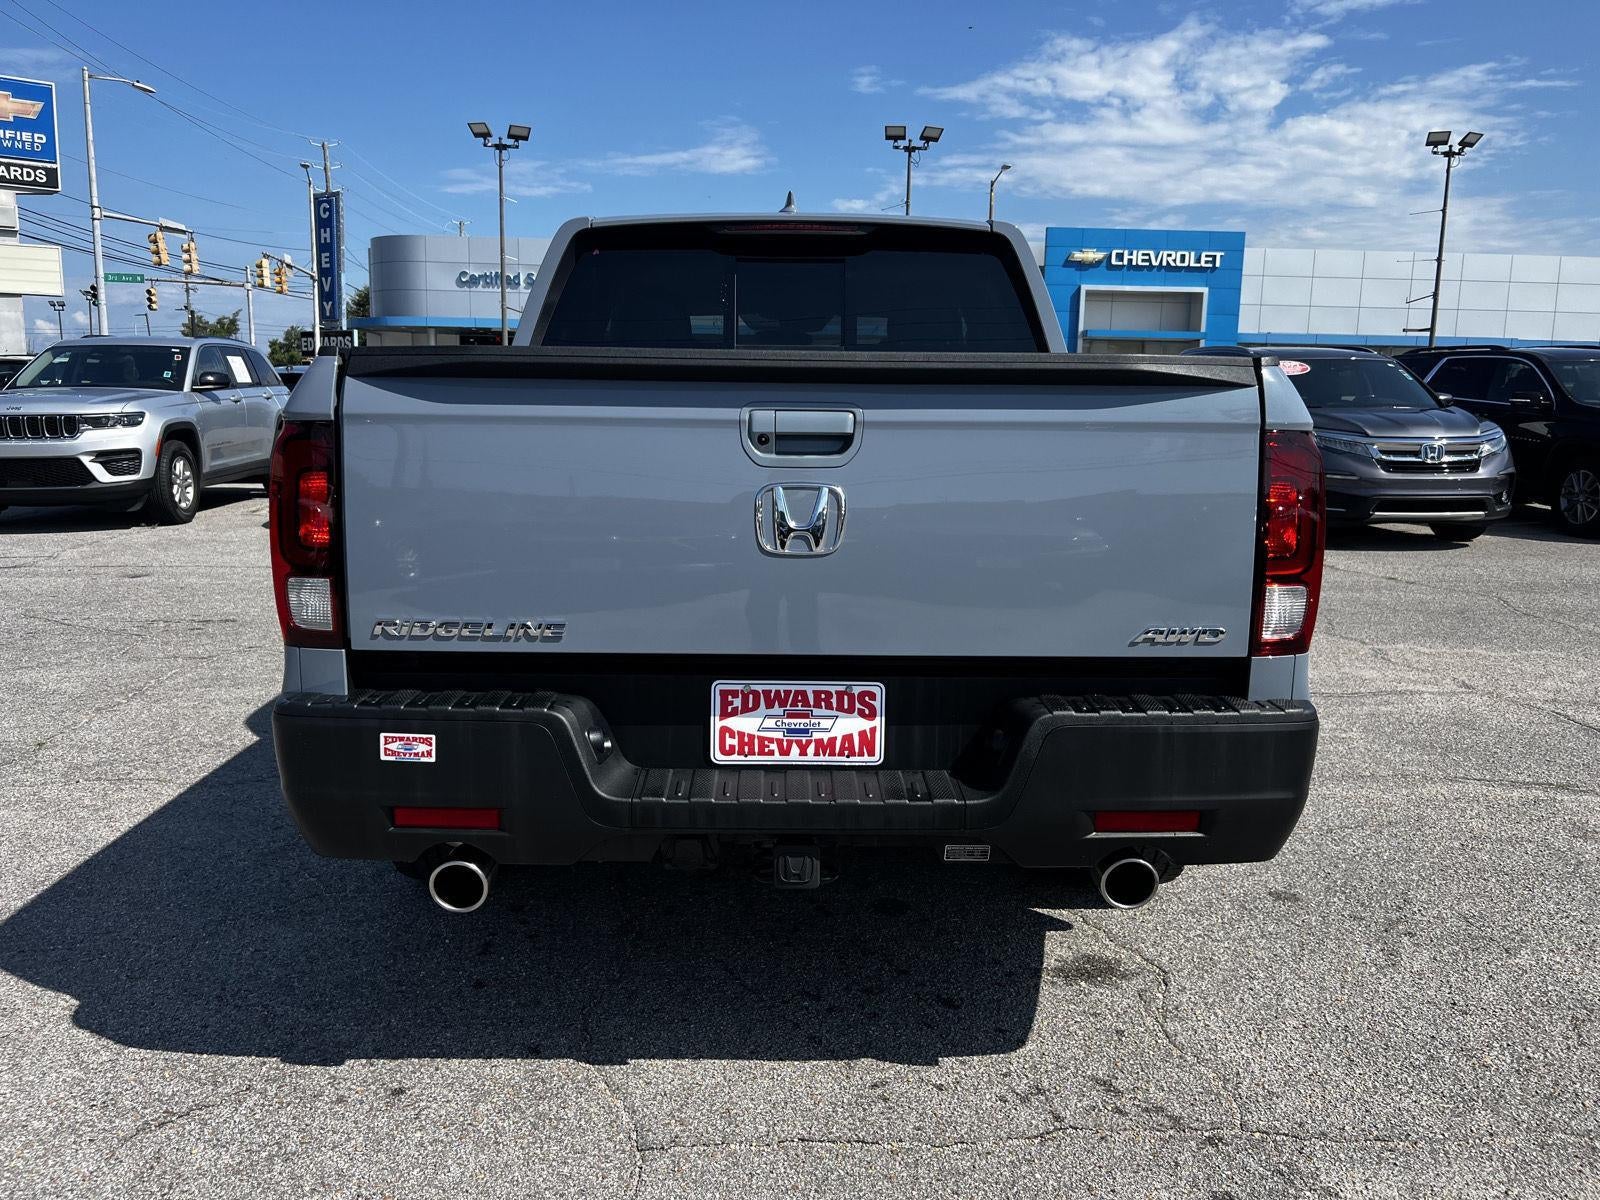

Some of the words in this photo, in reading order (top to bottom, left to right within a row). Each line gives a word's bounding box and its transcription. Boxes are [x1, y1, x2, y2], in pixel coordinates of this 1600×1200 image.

[2, 139, 42, 151] WNED
[0, 165, 47, 183] ARDS
[319, 202, 333, 316] CHEVY
[1111, 249, 1225, 268] CHEVROLET
[459, 270, 521, 287] Certifed
[301, 335, 352, 351] EDARDS
[370, 617, 566, 643] RIDGELINE
[1128, 626, 1227, 647] AWD
[718, 688, 878, 722] EDWARDS
[774, 719, 822, 728] Chevrolet
[383, 735, 433, 747] EDWARDS
[718, 725, 878, 758] CHEVYMAN
[383, 746, 433, 758] CHEVYMAN
